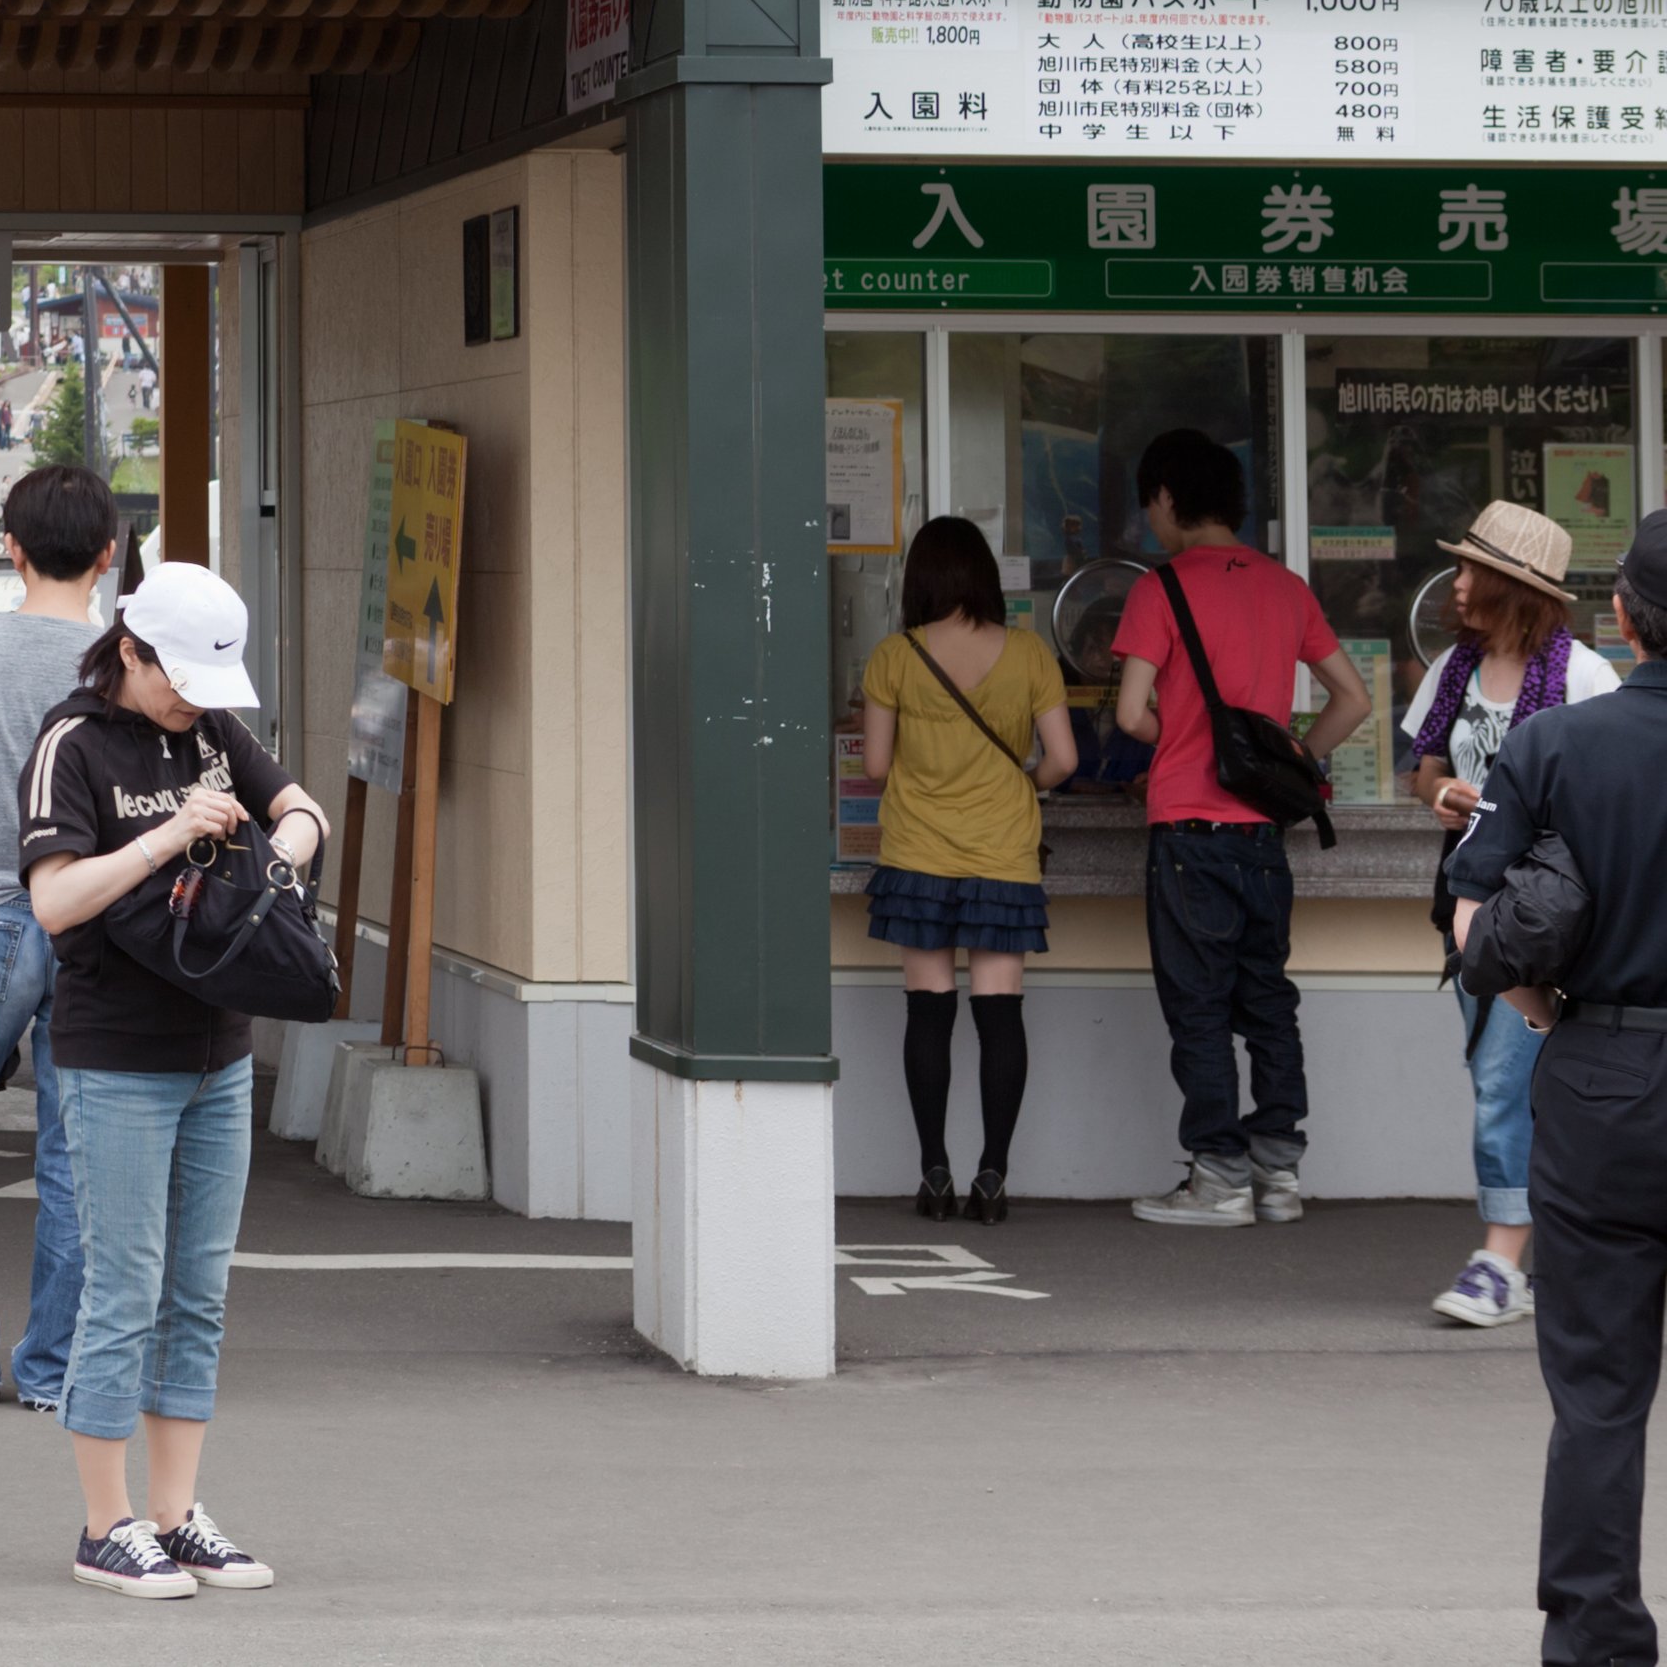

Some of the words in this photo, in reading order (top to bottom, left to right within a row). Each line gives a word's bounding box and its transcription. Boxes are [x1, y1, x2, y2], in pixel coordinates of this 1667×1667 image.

[926, 25, 980, 45] 1,800円
[1334, 36, 1398, 52] 800円
[1334, 59, 1398, 75] 580円
[1335, 81, 1398, 97] 700円
[864, 92, 988, 120] 入園料
[1335, 103, 1398, 120] 480円
[1040, 123, 1236, 141] 中学生以下
[1337, 125, 1395, 142] 無料
[861, 269, 970, 290] counter
[1190, 265, 1409, 294] 入园券销售机会
[1338, 382, 1608, 414] 旭川市民の方はお申し出ください
[1510, 449, 1539, 510] 泣い
